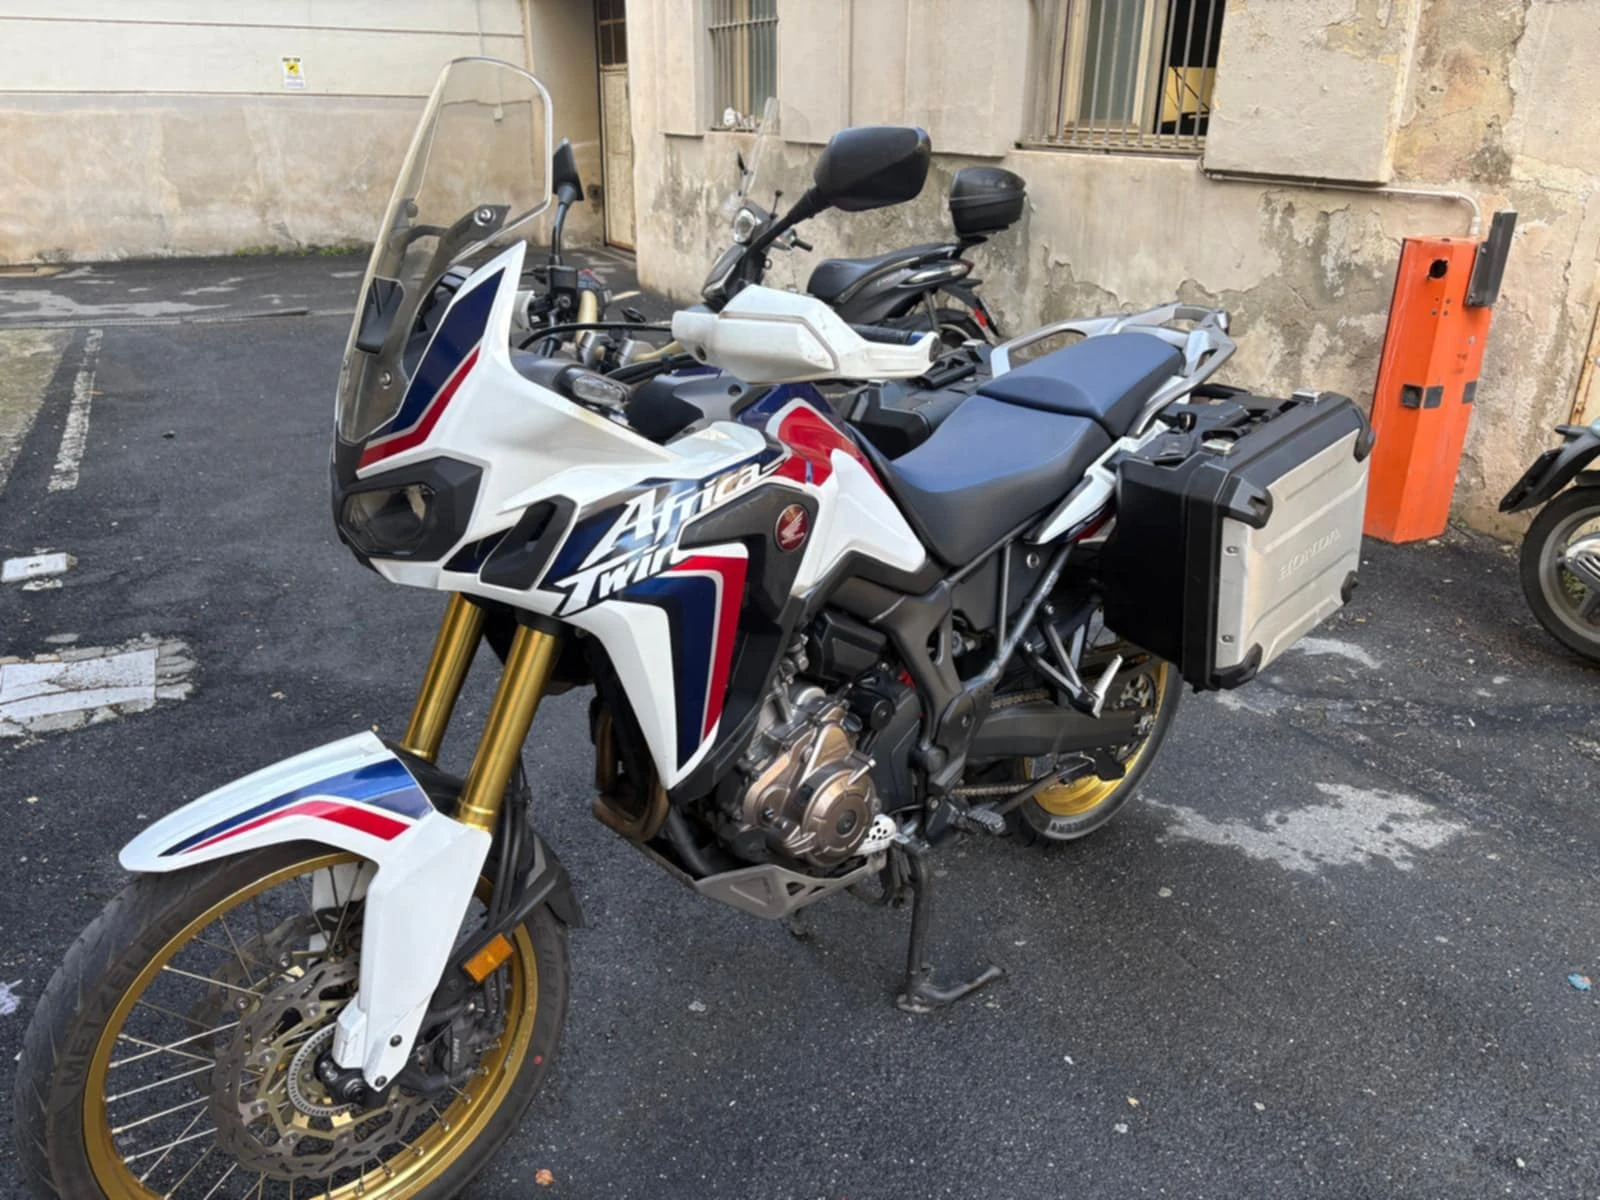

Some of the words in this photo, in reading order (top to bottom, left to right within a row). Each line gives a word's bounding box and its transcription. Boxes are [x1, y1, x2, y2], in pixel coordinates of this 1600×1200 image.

[577, 460, 786, 571] Africa
[554, 543, 679, 617] Twin
[1278, 528, 1342, 582] HONDA
